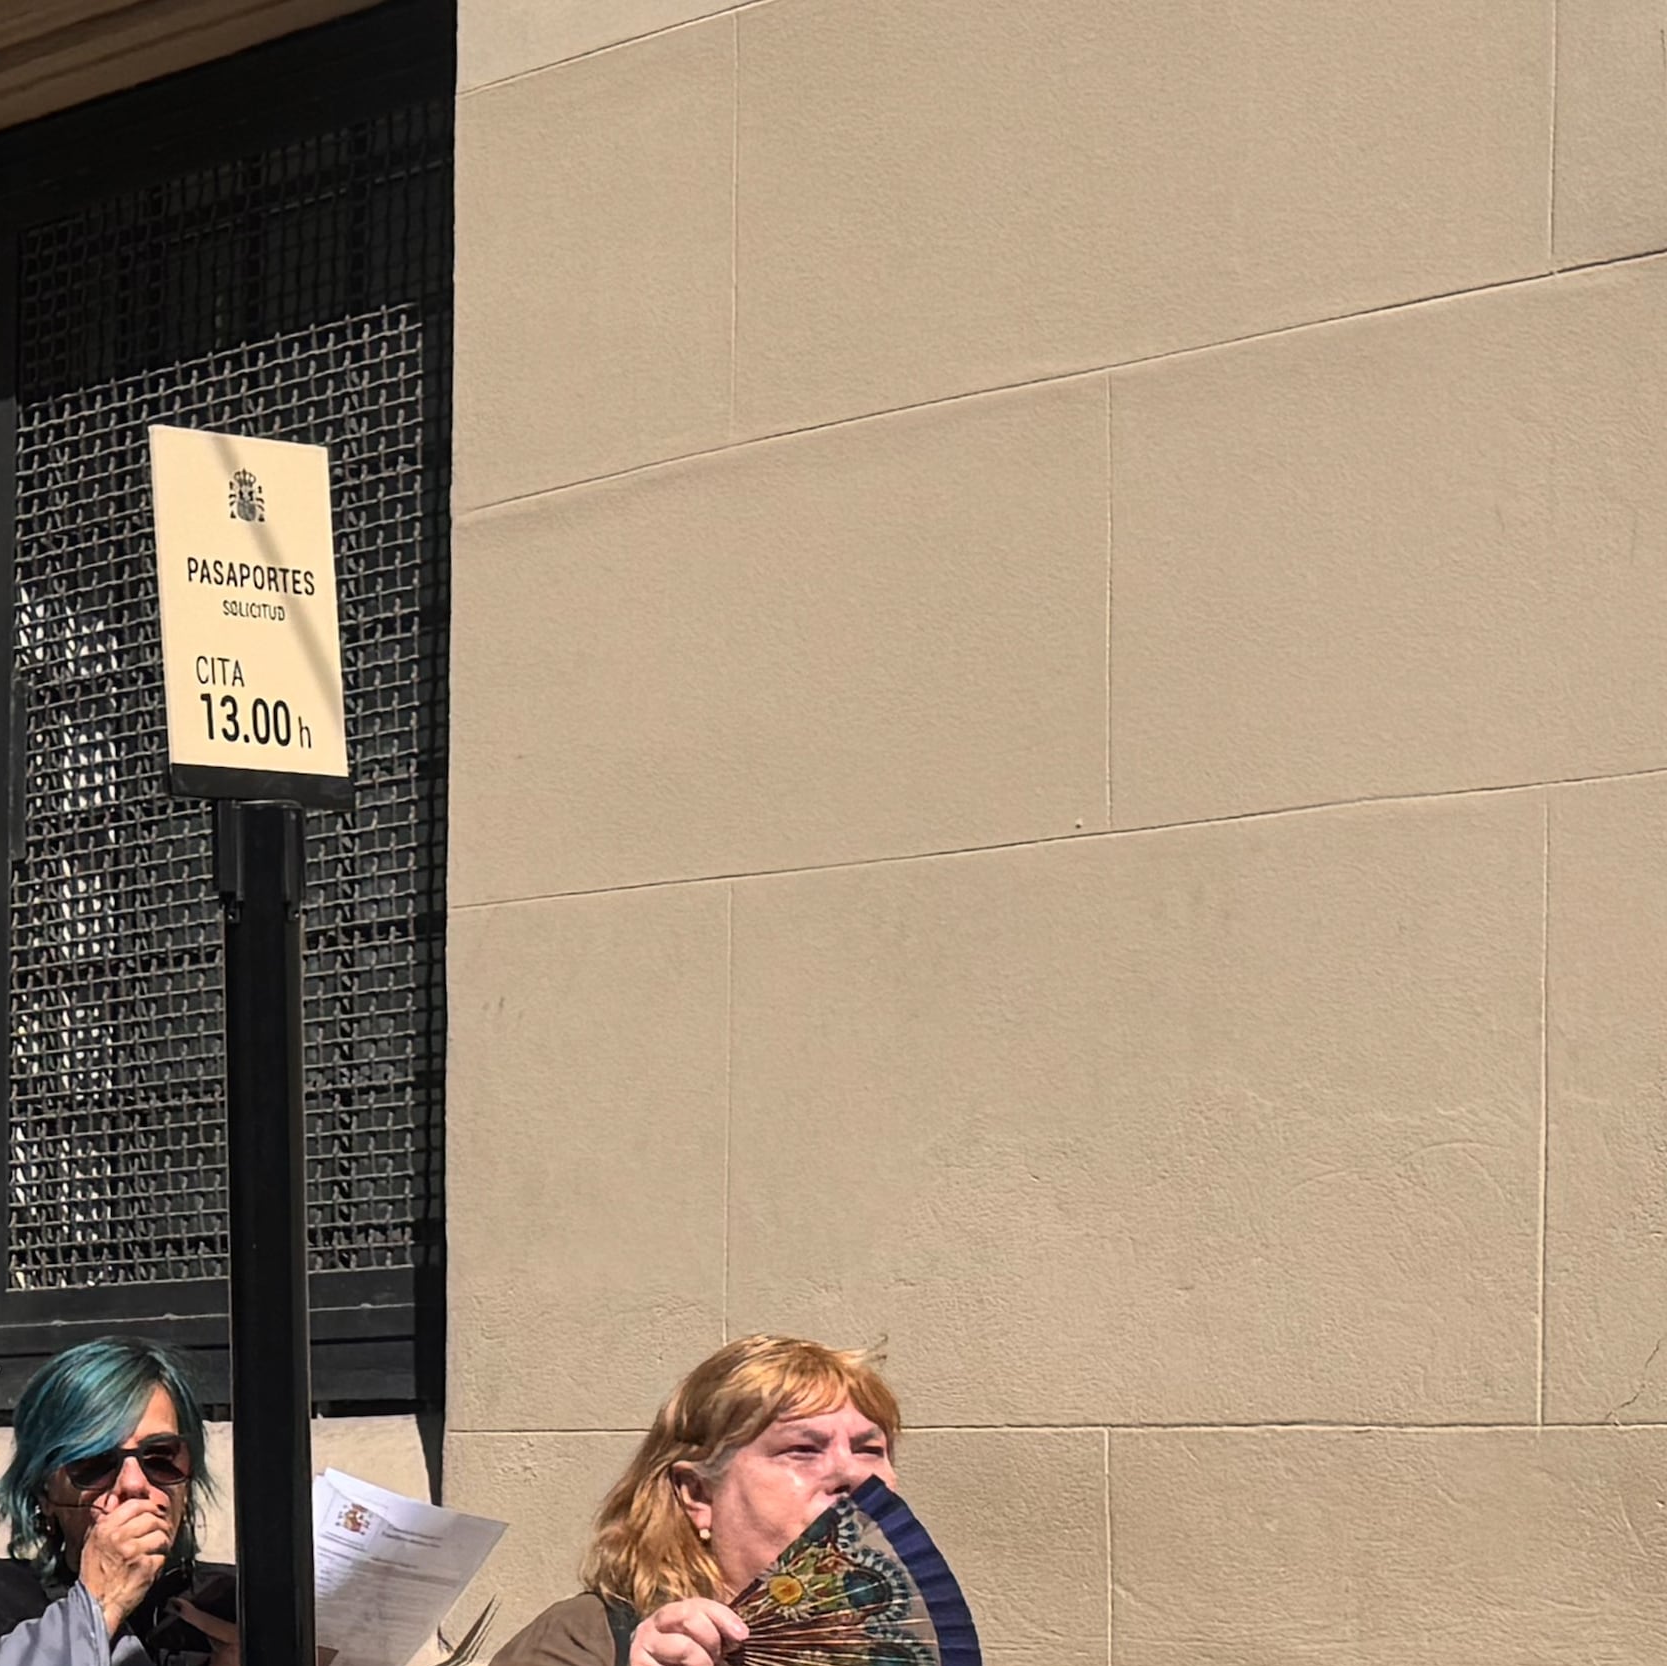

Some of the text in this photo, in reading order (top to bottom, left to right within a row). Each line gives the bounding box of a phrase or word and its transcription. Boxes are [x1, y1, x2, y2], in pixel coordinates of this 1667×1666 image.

[187, 557, 315, 596] PASAPORTES
[223, 600, 285, 622] SOLICITUD
[196, 656, 245, 687] CITA
[200, 693, 312, 748] 13.00 h
